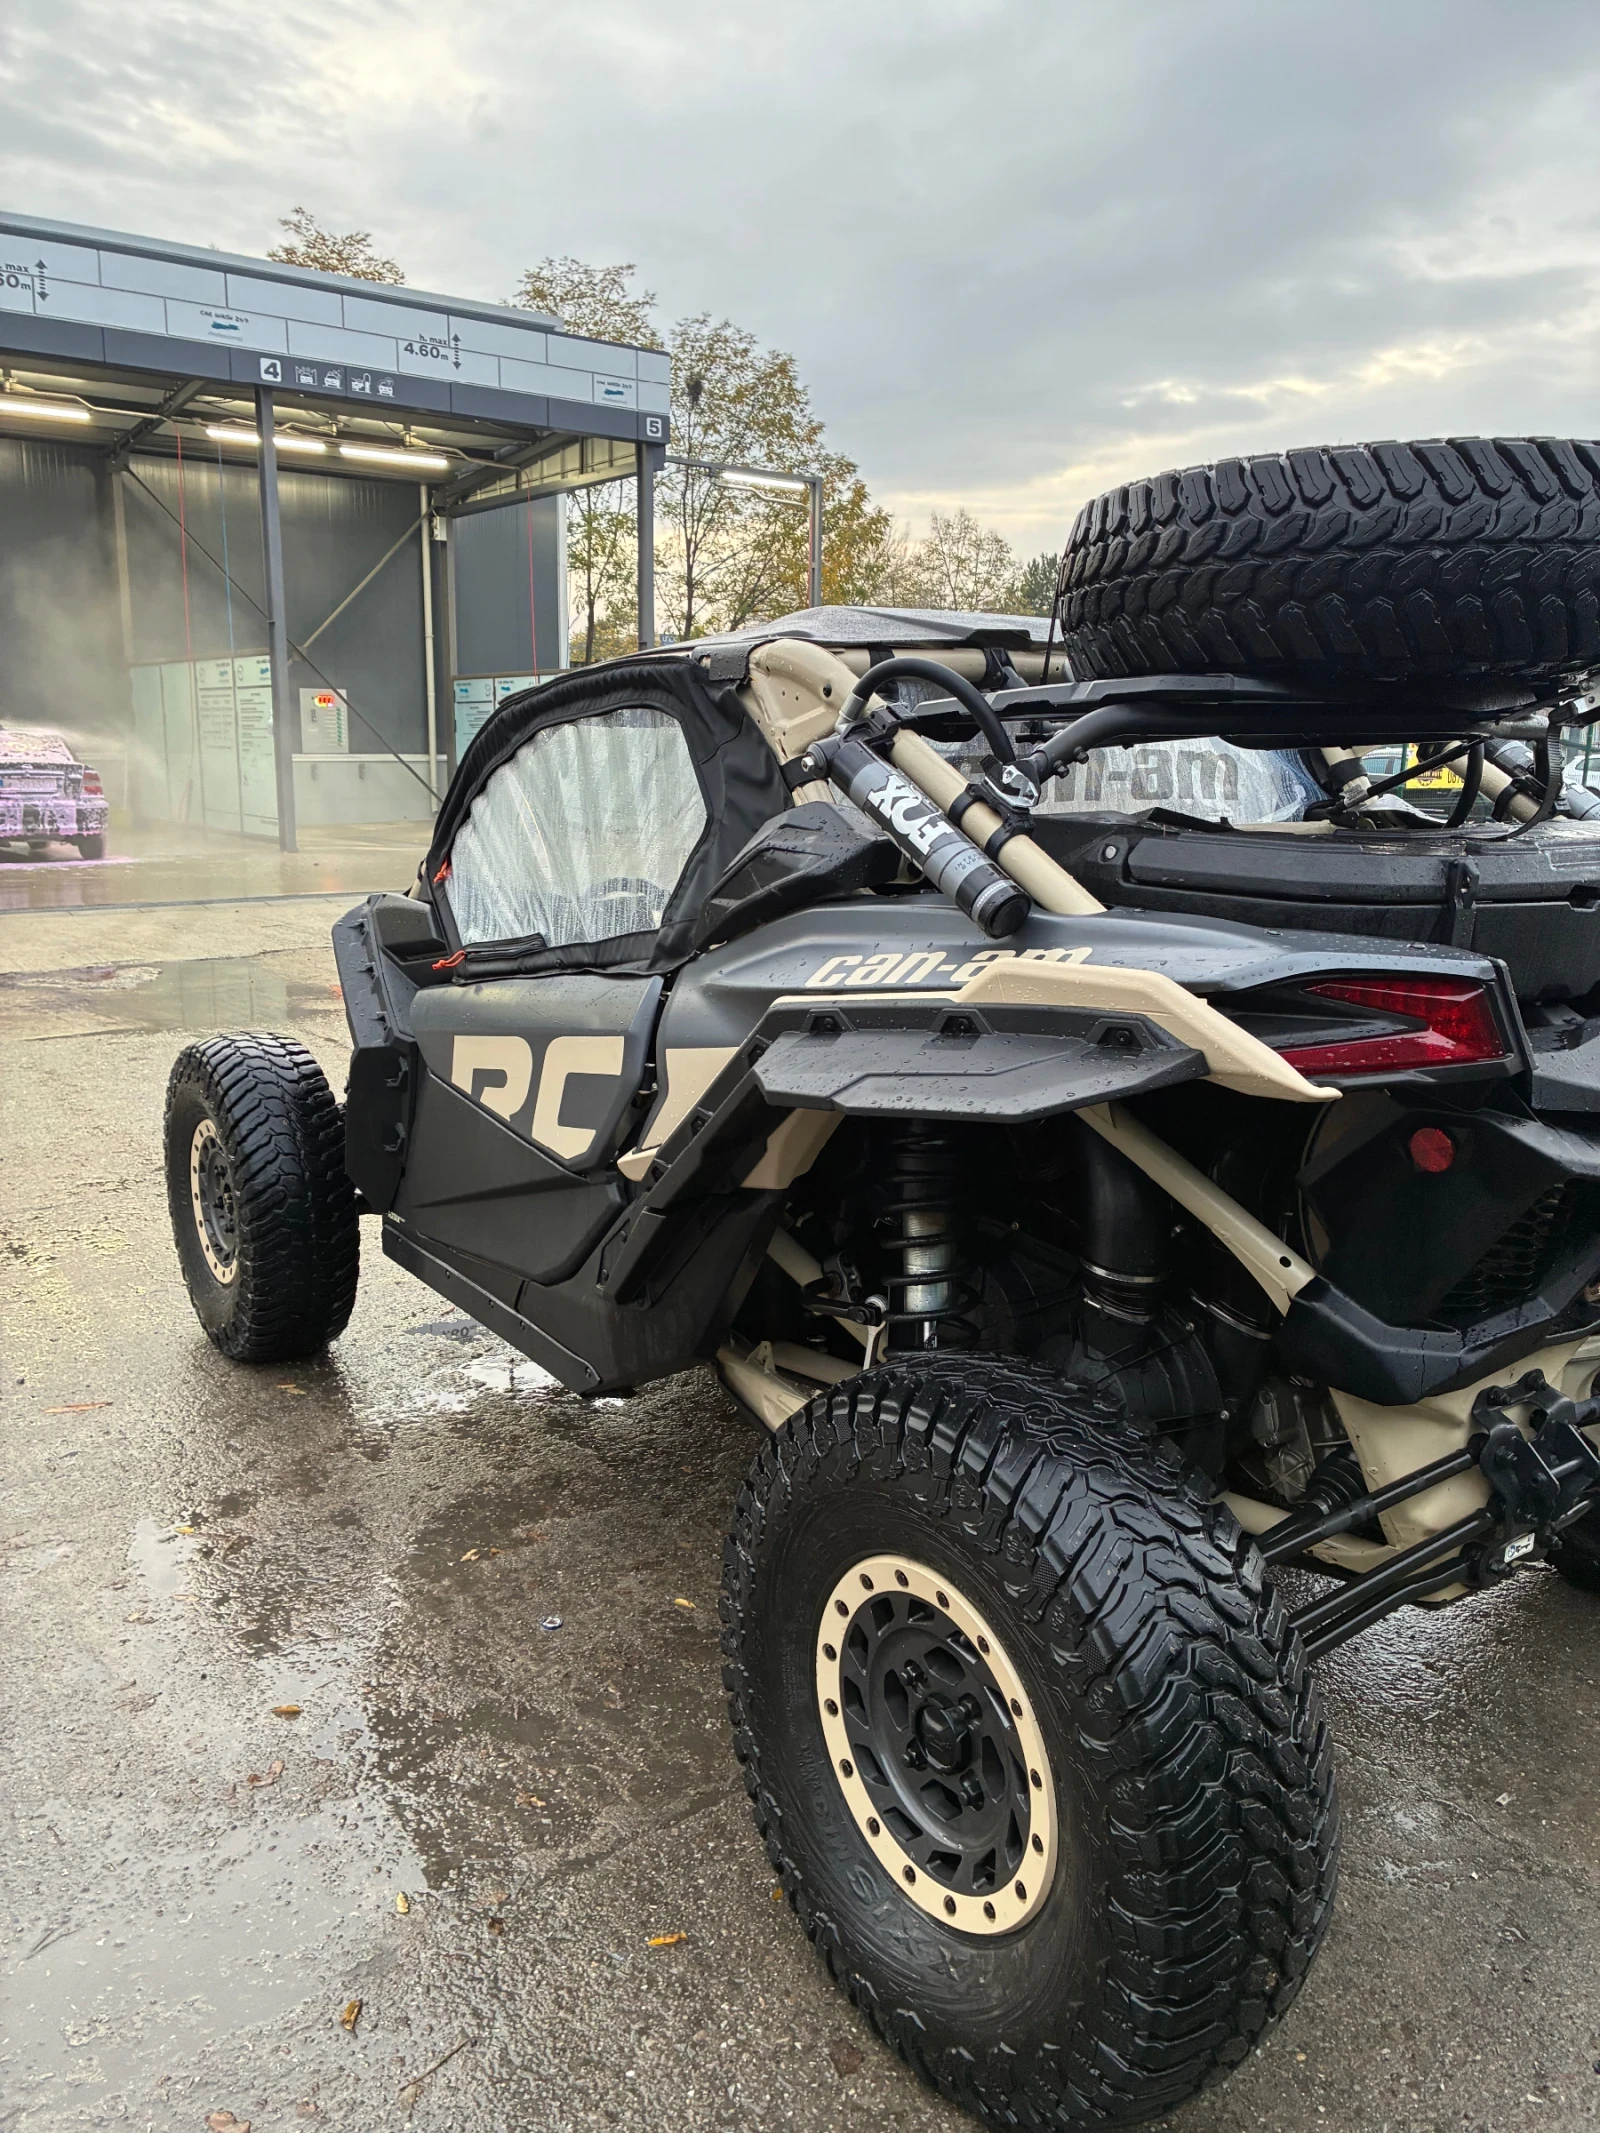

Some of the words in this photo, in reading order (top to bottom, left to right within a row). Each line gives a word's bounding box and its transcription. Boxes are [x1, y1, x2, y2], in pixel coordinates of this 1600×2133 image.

[5, 263, 29, 273] max
[429, 337, 448, 346] max
[263, 362, 279, 379] 4
[649, 420, 660, 434] 5
